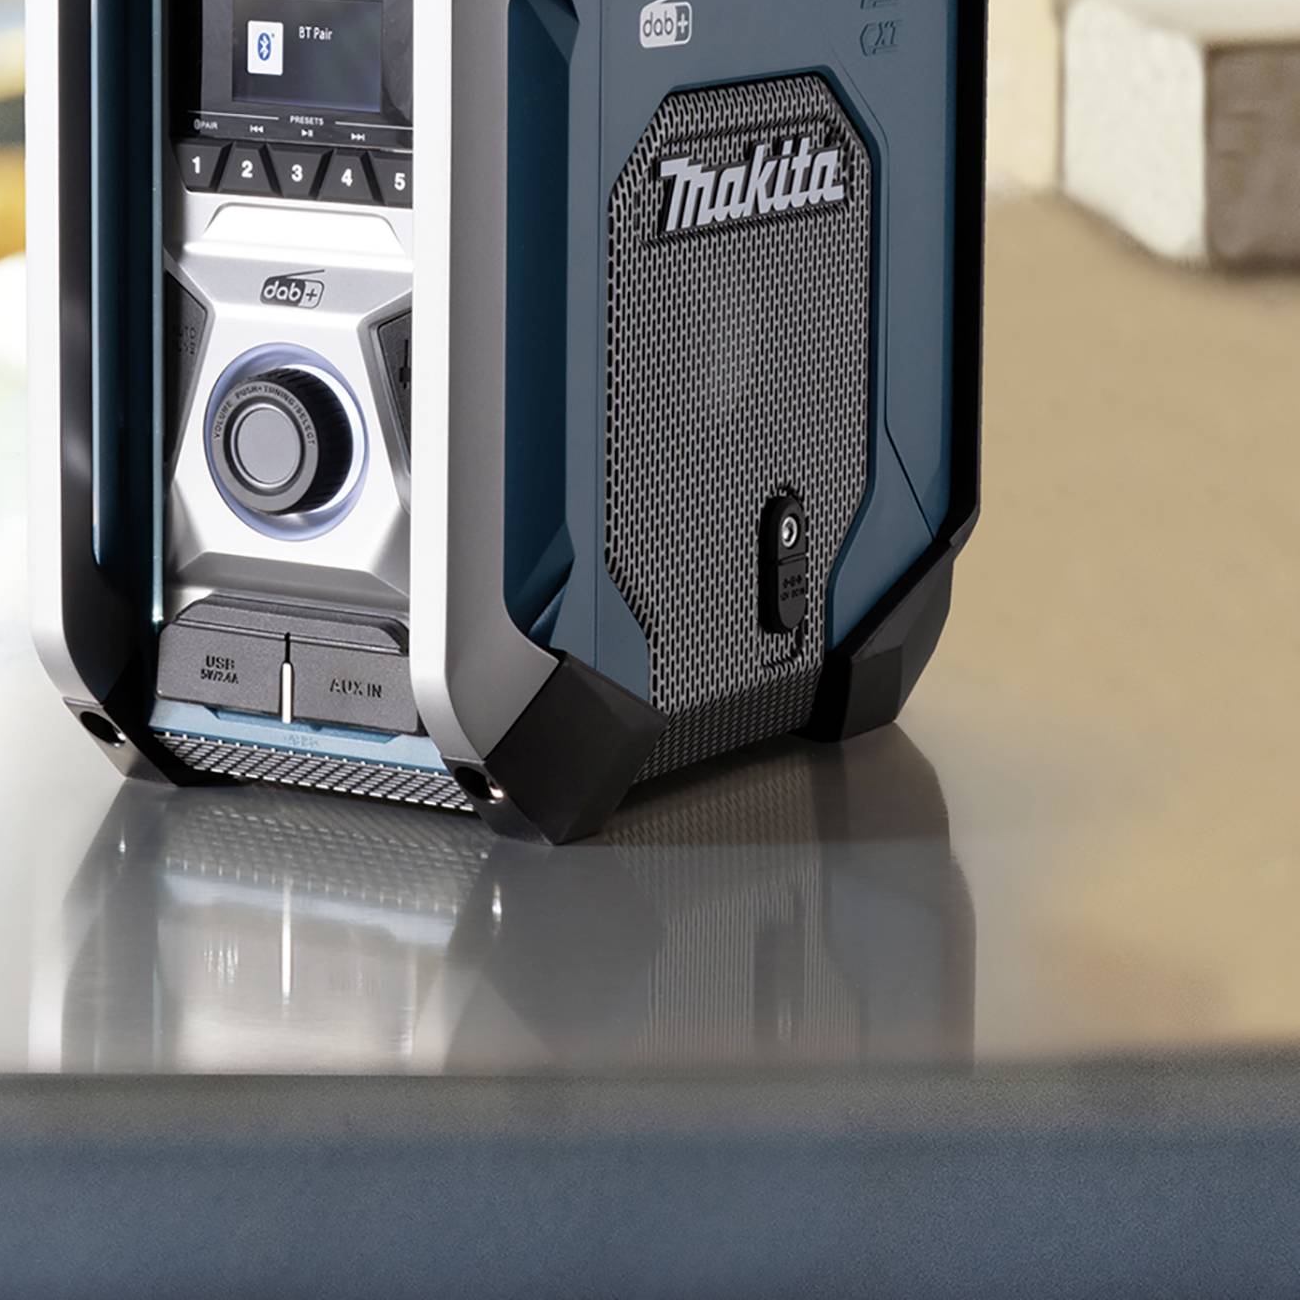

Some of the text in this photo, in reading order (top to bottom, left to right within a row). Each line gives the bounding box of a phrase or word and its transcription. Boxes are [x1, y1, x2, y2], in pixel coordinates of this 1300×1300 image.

[299, 26, 332, 40] BT Pair
[290, 115, 324, 126] PRESETS
[192, 156, 201, 173] 1
[241, 160, 253, 178] 2
[291, 164, 303, 181] 3
[341, 168, 353, 186] 4
[394, 173, 406, 190] 5
[660, 137, 844, 231] Makita
[206, 655, 235, 670] USB
[330, 678, 382, 698] AUX IN
